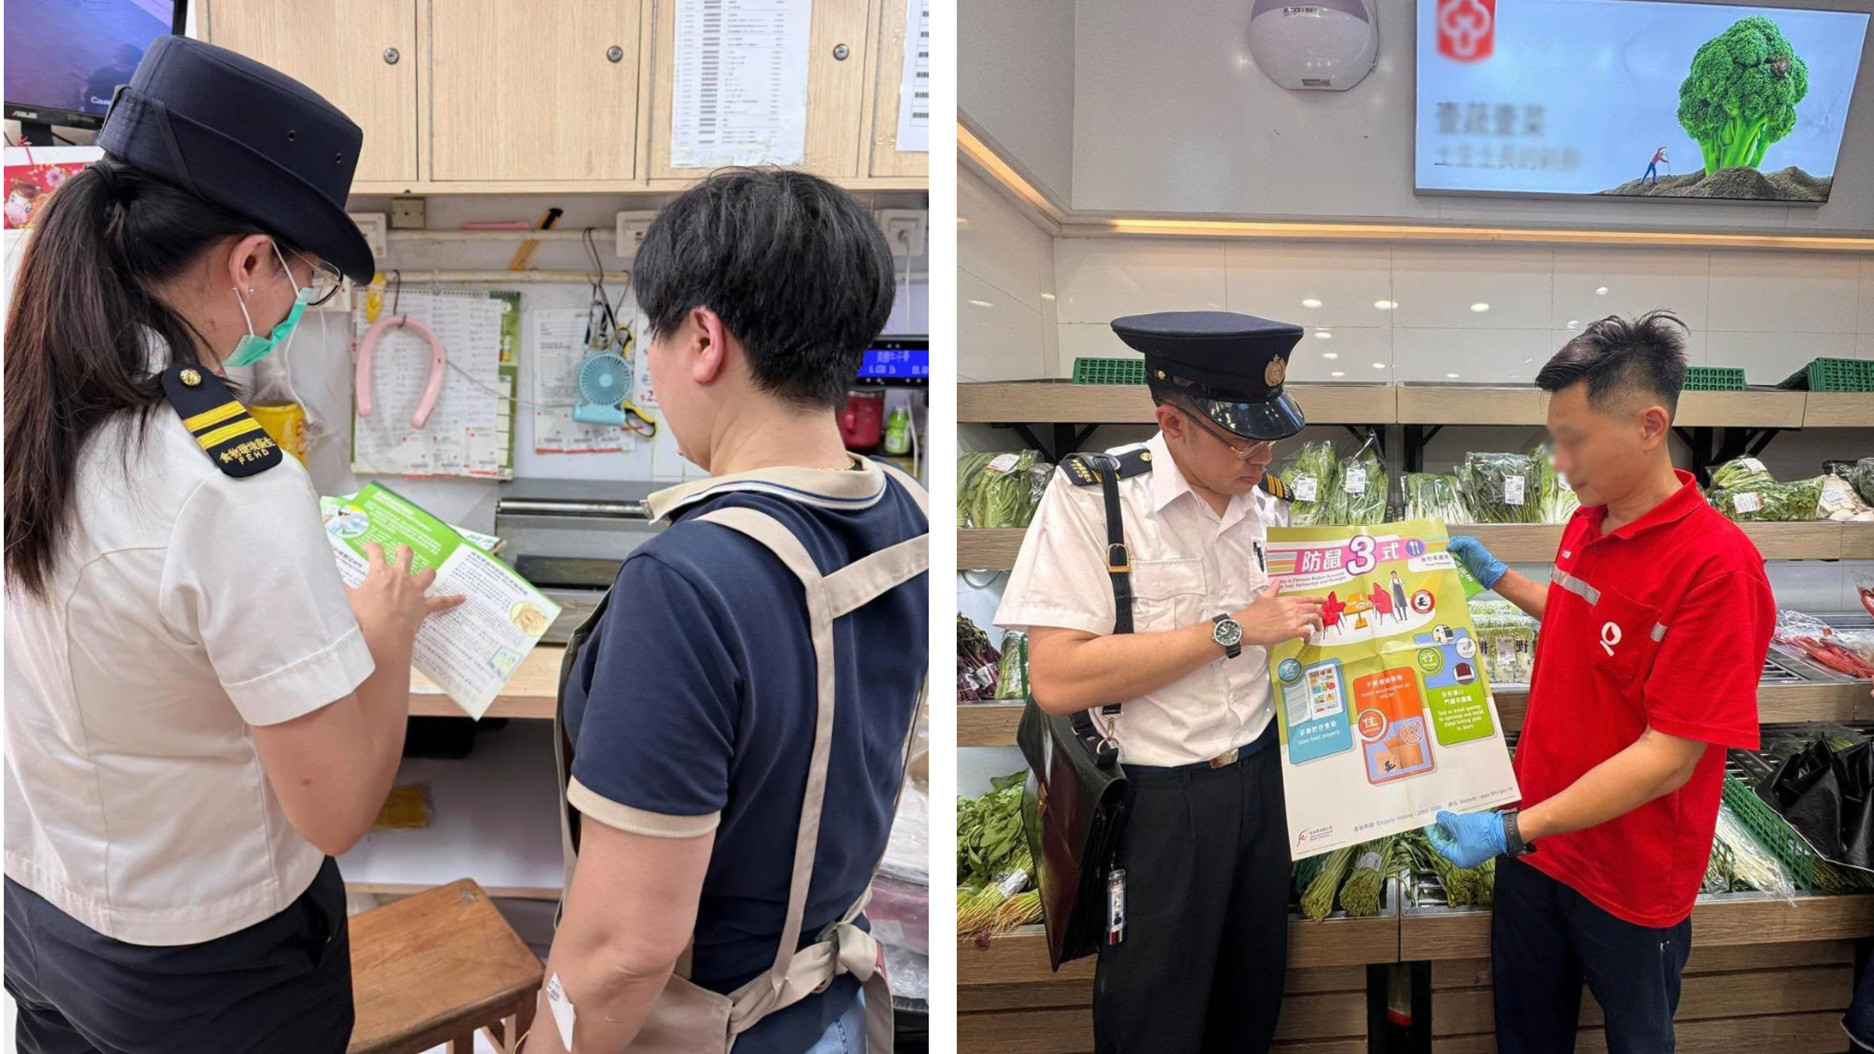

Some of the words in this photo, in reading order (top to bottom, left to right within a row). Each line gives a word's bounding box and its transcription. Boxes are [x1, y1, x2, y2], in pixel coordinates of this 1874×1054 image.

[12, 110, 38, 119] ASUS
[238, 448, 270, 466] FEHD
[1421, 652, 1435, 664] 行
[1362, 715, 1380, 730] 住
